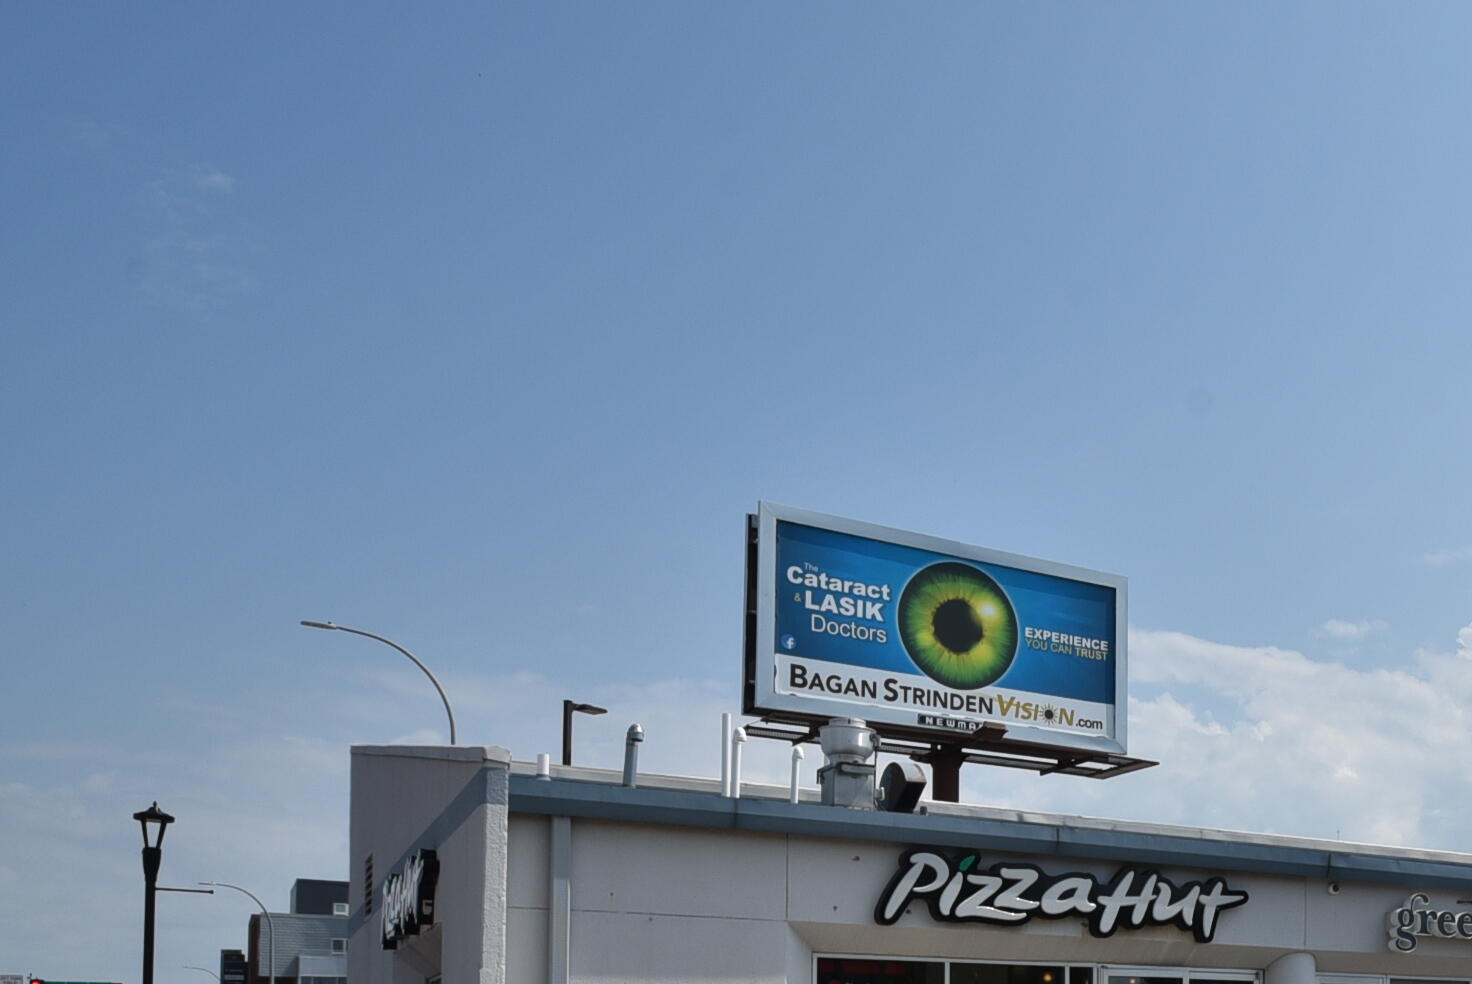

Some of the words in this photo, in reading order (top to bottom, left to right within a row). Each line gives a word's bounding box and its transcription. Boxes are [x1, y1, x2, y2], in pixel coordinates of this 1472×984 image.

[804, 562, 819, 572] The
[786, 565, 890, 601] Cataract
[804, 590, 884, 622] LASIK
[811, 613, 887, 643] Doctors
[1024, 626, 1109, 651] EXPERIENCE
[1025, 639, 1048, 651] YOU
[1050, 643, 1072, 655] CAN
[1075, 647, 1108, 661] TRUST
[925, 716, 984, 732] NEWMA
[884, 852, 1096, 921] Pizza
[1097, 869, 1245, 938] Hut
